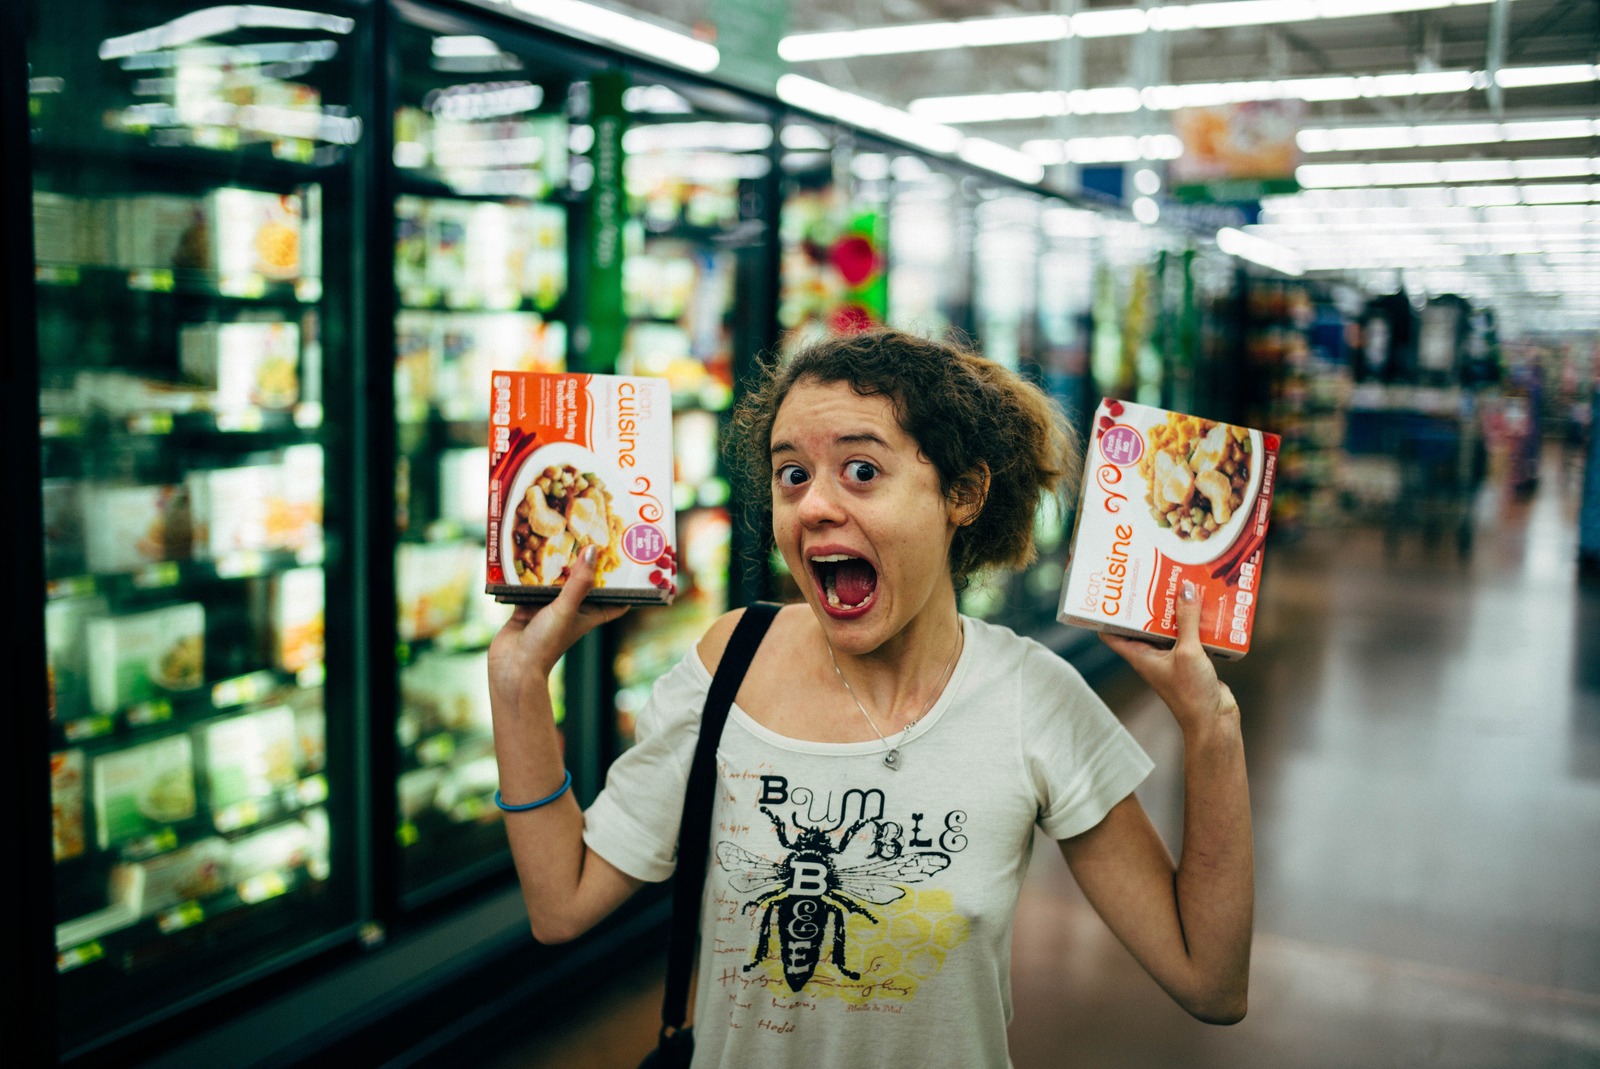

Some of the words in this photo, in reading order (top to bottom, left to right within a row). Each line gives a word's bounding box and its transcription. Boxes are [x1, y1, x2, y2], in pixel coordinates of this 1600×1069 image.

[556, 379, 567, 430] Tenderloins
[566, 378, 578, 410] Glazed
[564, 410, 578, 440] Turkey
[618, 382, 640, 469] cuisine
[1105, 434, 1115, 453] fresh
[1101, 524, 1133, 616] cuisine
[1165, 565, 1183, 597] Turkey
[1079, 570, 1103, 612] lean
[1160, 597, 1176, 631] Glazed
[786, 859, 830, 975] BEE
